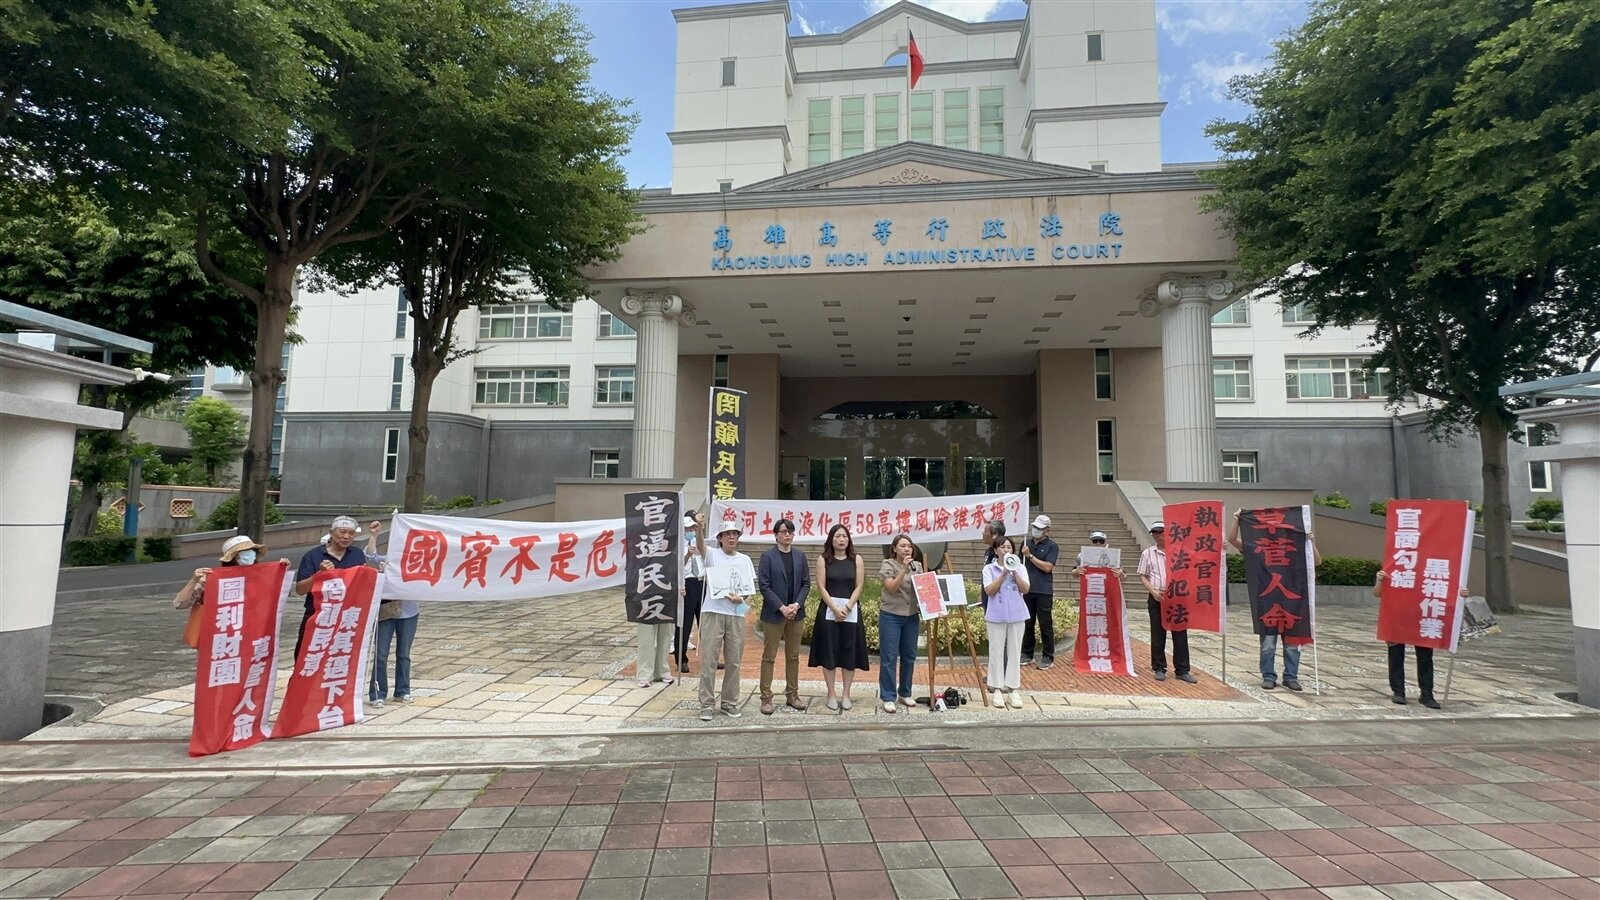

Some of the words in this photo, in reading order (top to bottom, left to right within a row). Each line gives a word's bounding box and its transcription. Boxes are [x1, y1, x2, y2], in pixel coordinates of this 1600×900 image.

[711, 253, 811, 270] KAOHSIUNG
[826, 251, 868, 267] HIGH
[883, 246, 1035, 265] ADMINISTRATIVE
[1053, 243, 1122, 260] COURT
[713, 212, 1123, 252] 高雄高等行政法院
[400, 528, 626, 589] 國賓不是危
[635, 496, 674, 620] 官逼民反
[1166, 522, 1192, 625] 知法犯法
[1194, 506, 1219, 605] 執政官員
[1251, 507, 1303, 634] 草菅人命
[1390, 508, 1422, 589] 官商勾結
[208, 576, 246, 687] 圖利財團
[1419, 558, 1450, 639] 黑箱作業
[232, 635, 271, 742] 草菅人命
